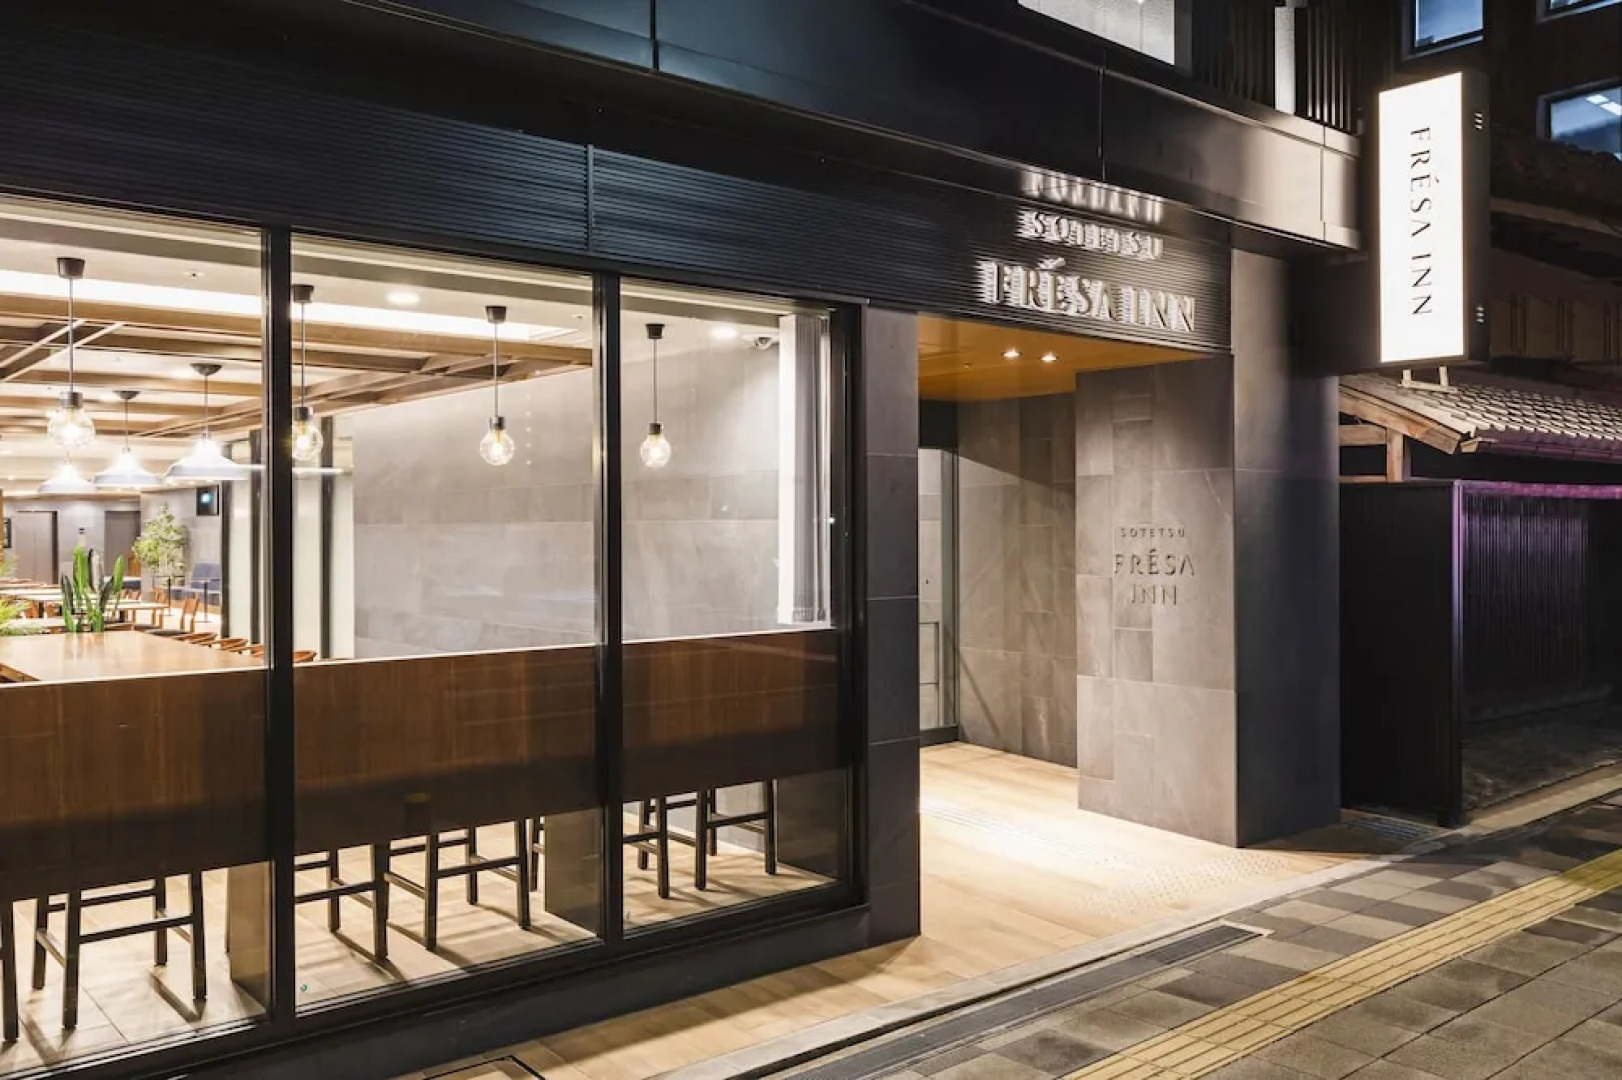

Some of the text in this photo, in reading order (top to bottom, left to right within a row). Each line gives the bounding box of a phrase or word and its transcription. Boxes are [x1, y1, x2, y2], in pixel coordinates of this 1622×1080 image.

[1410, 126, 1440, 316] FRÉSA INN
[982, 256, 1196, 333] FRÉSA INN
[1120, 528, 1185, 538] SOTETSU
[1114, 547, 1195, 577] FRÉSA
[1131, 583, 1177, 606] INN
